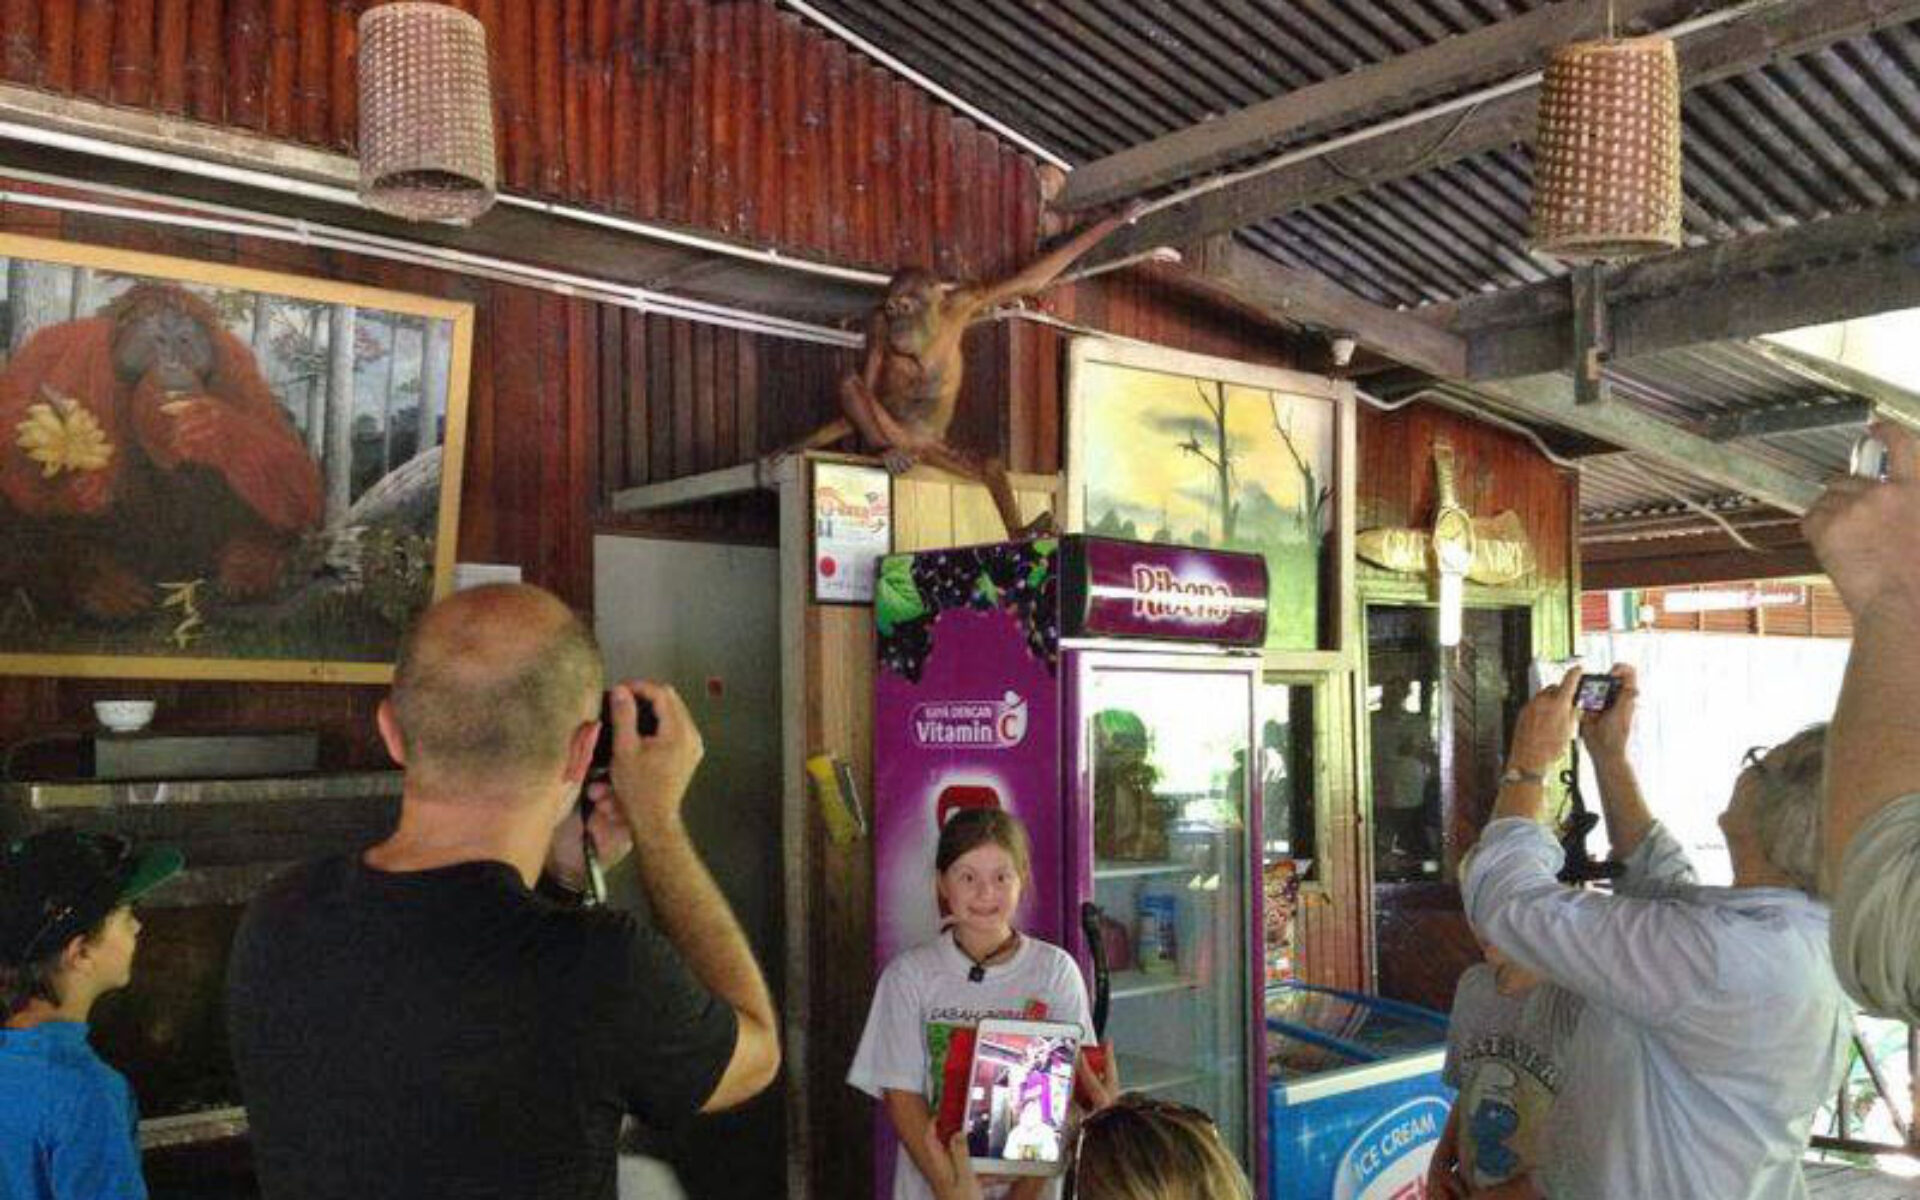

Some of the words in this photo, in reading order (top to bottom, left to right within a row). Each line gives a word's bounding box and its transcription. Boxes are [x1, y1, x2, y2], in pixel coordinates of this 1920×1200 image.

[916, 719, 993, 743] Vitamin
[1000, 713, 1019, 741] C
[1349, 1145, 1381, 1185] ICE
[1381, 1111, 1438, 1156] CREAM
